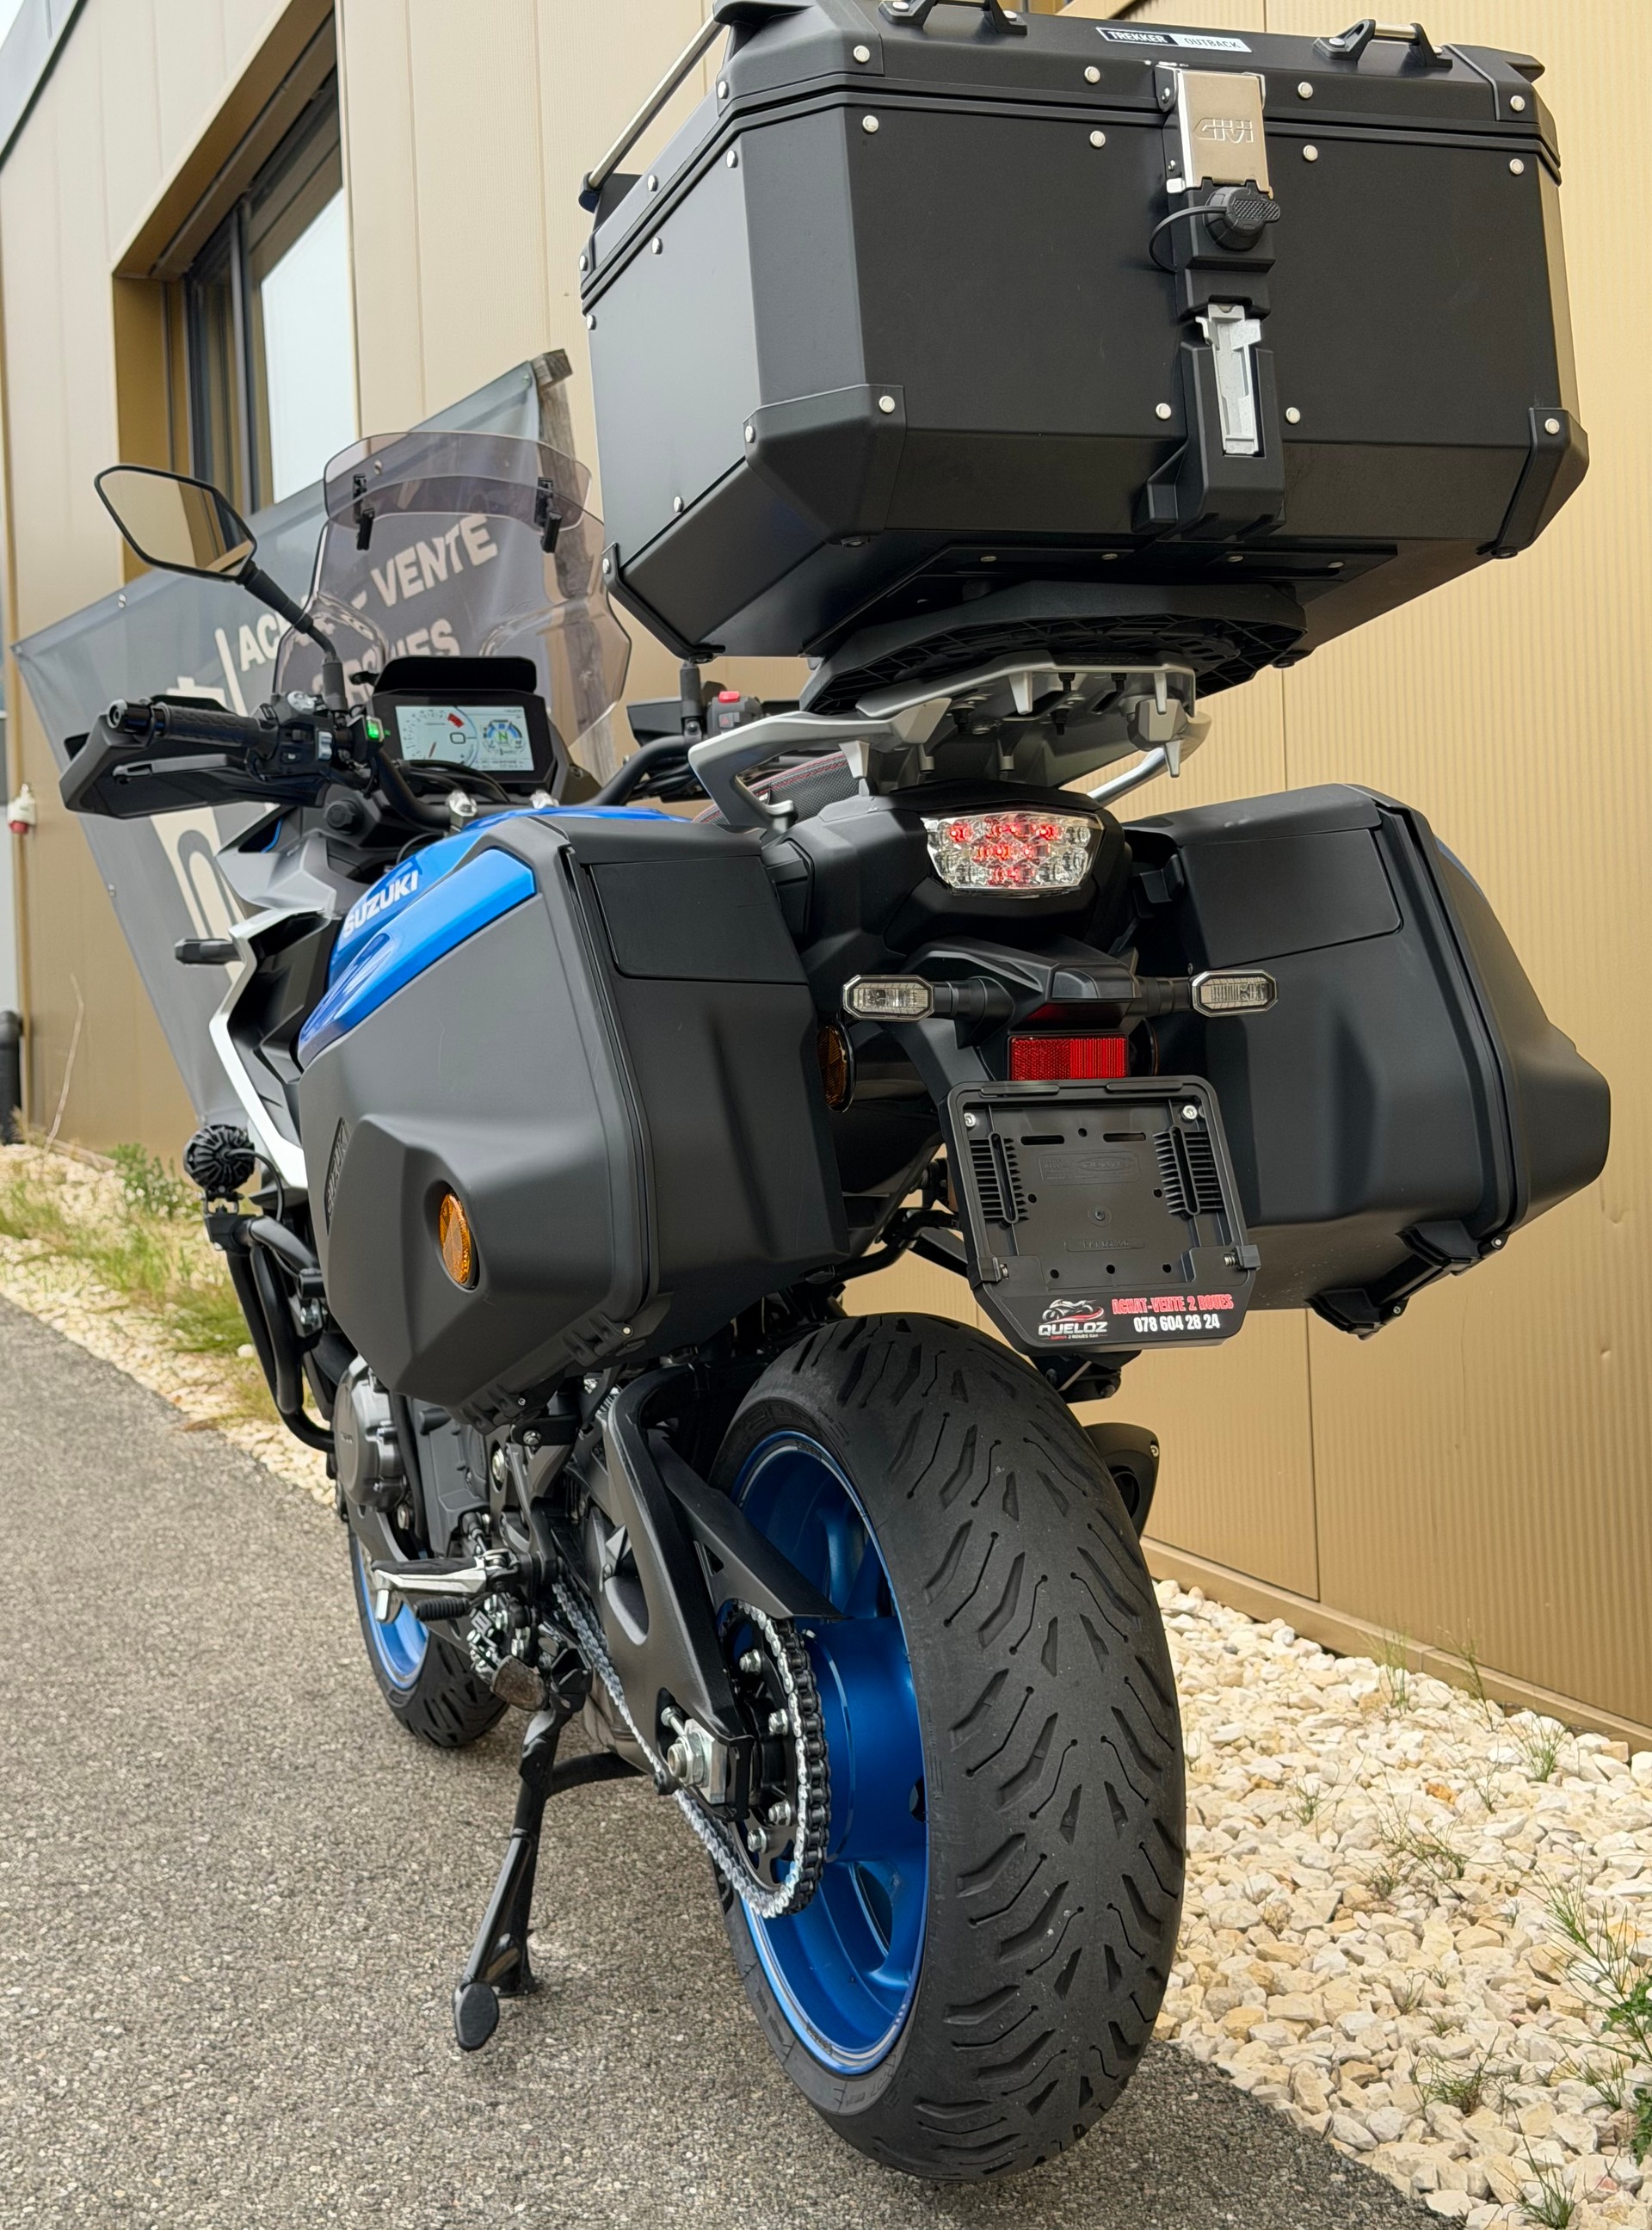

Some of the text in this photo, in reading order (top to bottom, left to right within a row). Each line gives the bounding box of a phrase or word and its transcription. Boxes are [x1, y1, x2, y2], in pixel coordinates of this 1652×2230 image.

[1107, 30, 1242, 49] TREKKER OUTBACK
[1193, 118, 1254, 144] GIVI
[370, 514, 498, 608] VENTE
[343, 869, 418, 939] SUZUKI
[1112, 1294, 1234, 1315] ACHAT-VENTE 2 ROUES
[1038, 1321, 1108, 1336] QUELOZ
[1133, 1313, 1220, 1333] 078 604 28 24
